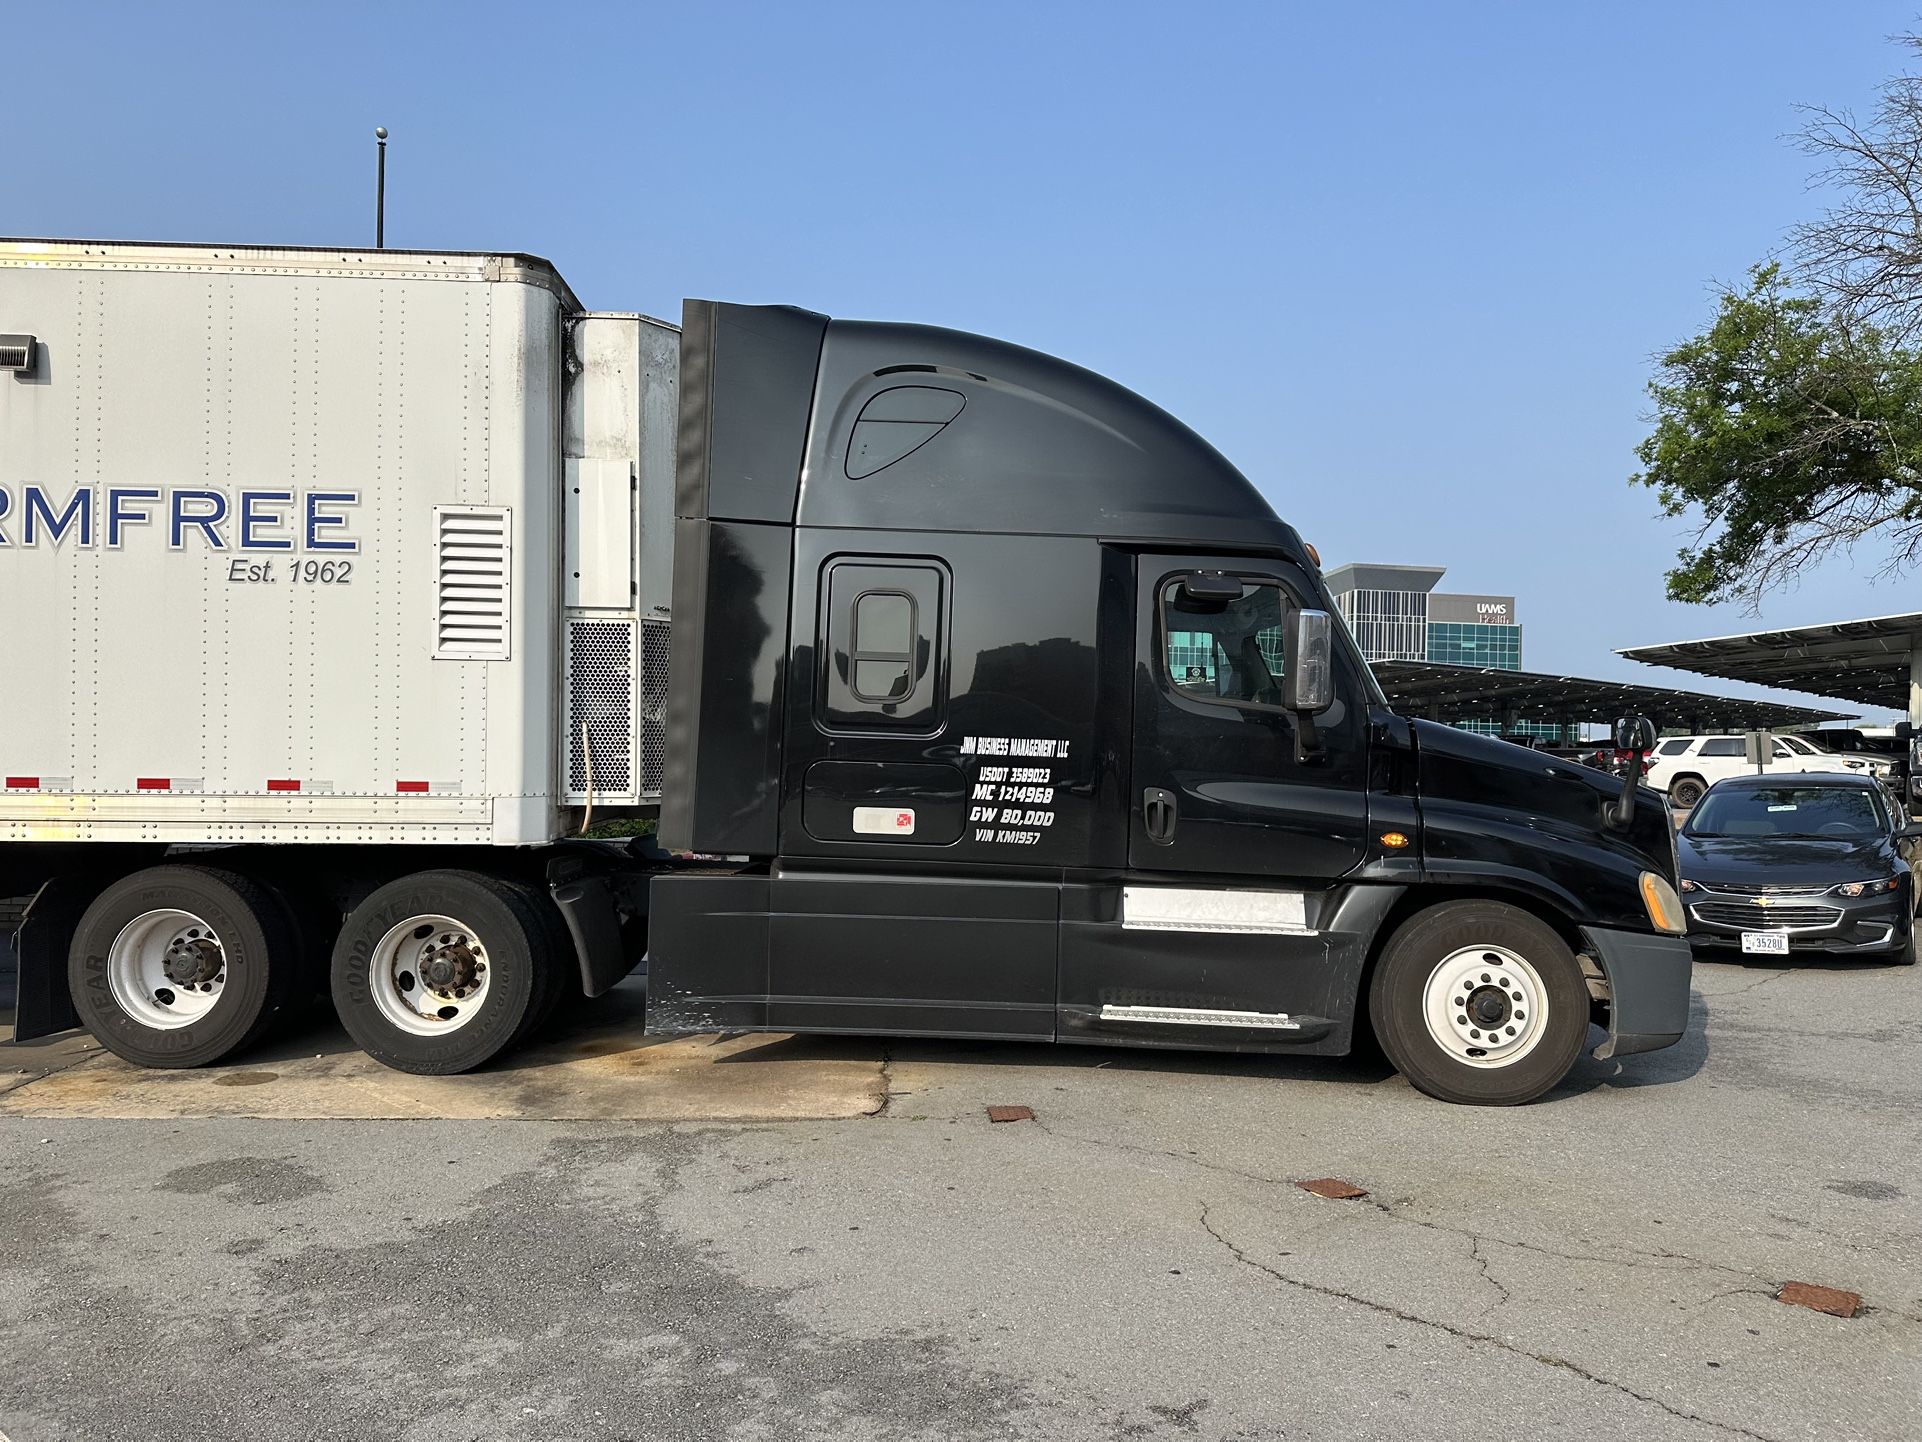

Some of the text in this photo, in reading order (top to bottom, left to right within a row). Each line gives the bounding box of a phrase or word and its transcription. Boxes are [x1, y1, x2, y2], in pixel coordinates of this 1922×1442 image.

[229, 560, 353, 583] Est. 1962
[1476, 603, 1507, 614] UAMS
[976, 737, 1009, 756] BUSINESS
[1009, 738, 1057, 758] MANAGEMENT
[1056, 740, 1070, 758] LLC
[979, 766, 1051, 783] USDOT 3589023
[971, 783, 1054, 804] MC 1214968
[969, 806, 1055, 826] GW 80,000
[975, 828, 1041, 845] VIN KM1957
[347, 894, 443, 1003] GOODYEAR
[1756, 937, 1783, 949] 3528U
